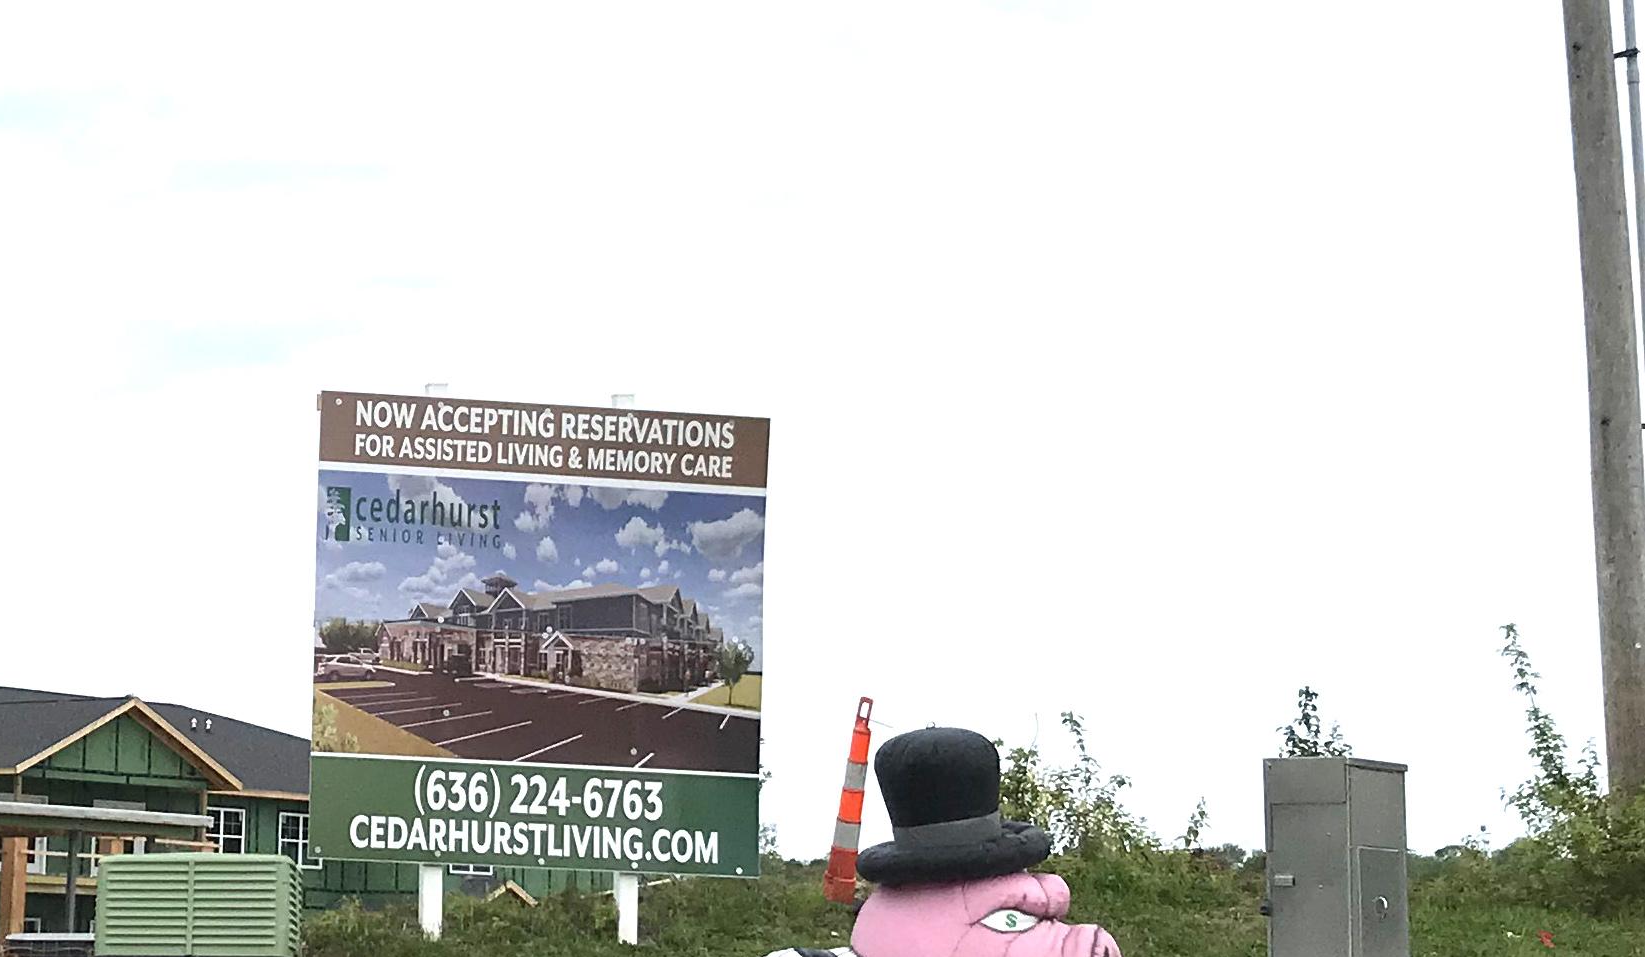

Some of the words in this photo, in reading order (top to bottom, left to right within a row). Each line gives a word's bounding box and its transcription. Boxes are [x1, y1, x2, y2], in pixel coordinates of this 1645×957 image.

[356, 400, 416, 429] NOW
[421, 404, 555, 437] ACCEPTING
[561, 413, 735, 449] RESERVATIONS
[354, 434, 395, 458] FOR
[399, 437, 493, 463] ASSISTED
[497, 442, 563, 468] LIVING
[568, 447, 583, 469] &
[587, 448, 677, 475] MEMORY
[681, 454, 733, 478] CARE
[356, 489, 501, 530] cedarhurst
[356, 526, 424, 545] SENIOR
[437, 532, 501, 549] LIVING
[414, 764, 501, 819] (636)
[509, 773, 664, 821] 224-6763
[349, 814, 719, 864] CEDARHURSTLIVING.COM
